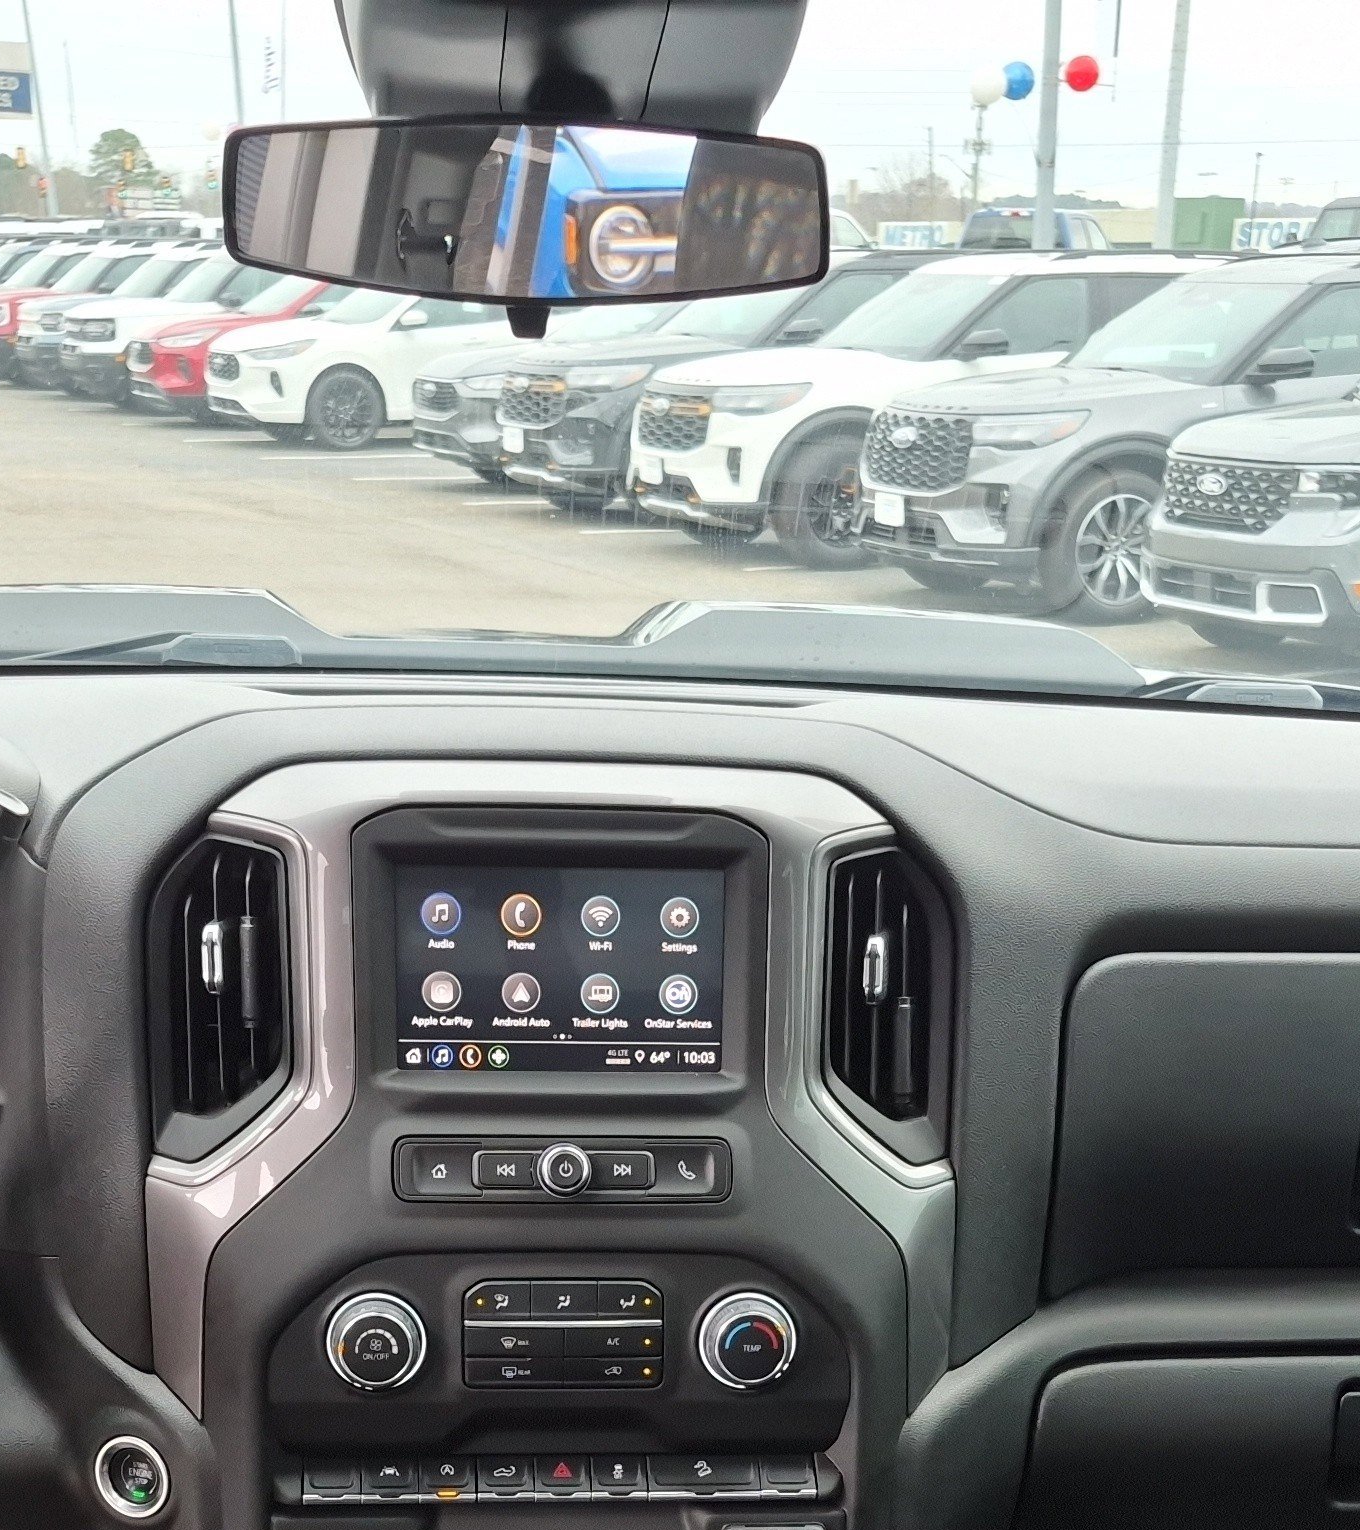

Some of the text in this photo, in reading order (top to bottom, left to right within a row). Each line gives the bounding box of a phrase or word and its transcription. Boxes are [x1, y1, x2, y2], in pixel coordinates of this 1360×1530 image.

[428, 938, 455, 949] Audio
[507, 940, 536, 951] Phone
[588, 941, 613, 951] Wi-Fi
[661, 942, 698, 954] Settings
[411, 1015, 473, 1028] Apple CarPlay
[492, 1017, 551, 1028] Android Auto
[571, 1017, 629, 1030] Trailer Lights
[644, 1018, 712, 1029] OnStar Services
[683, 1051, 716, 1064] 10:03
[606, 1337, 620, 1346] A/C
[743, 1344, 761, 1352] TEMP
